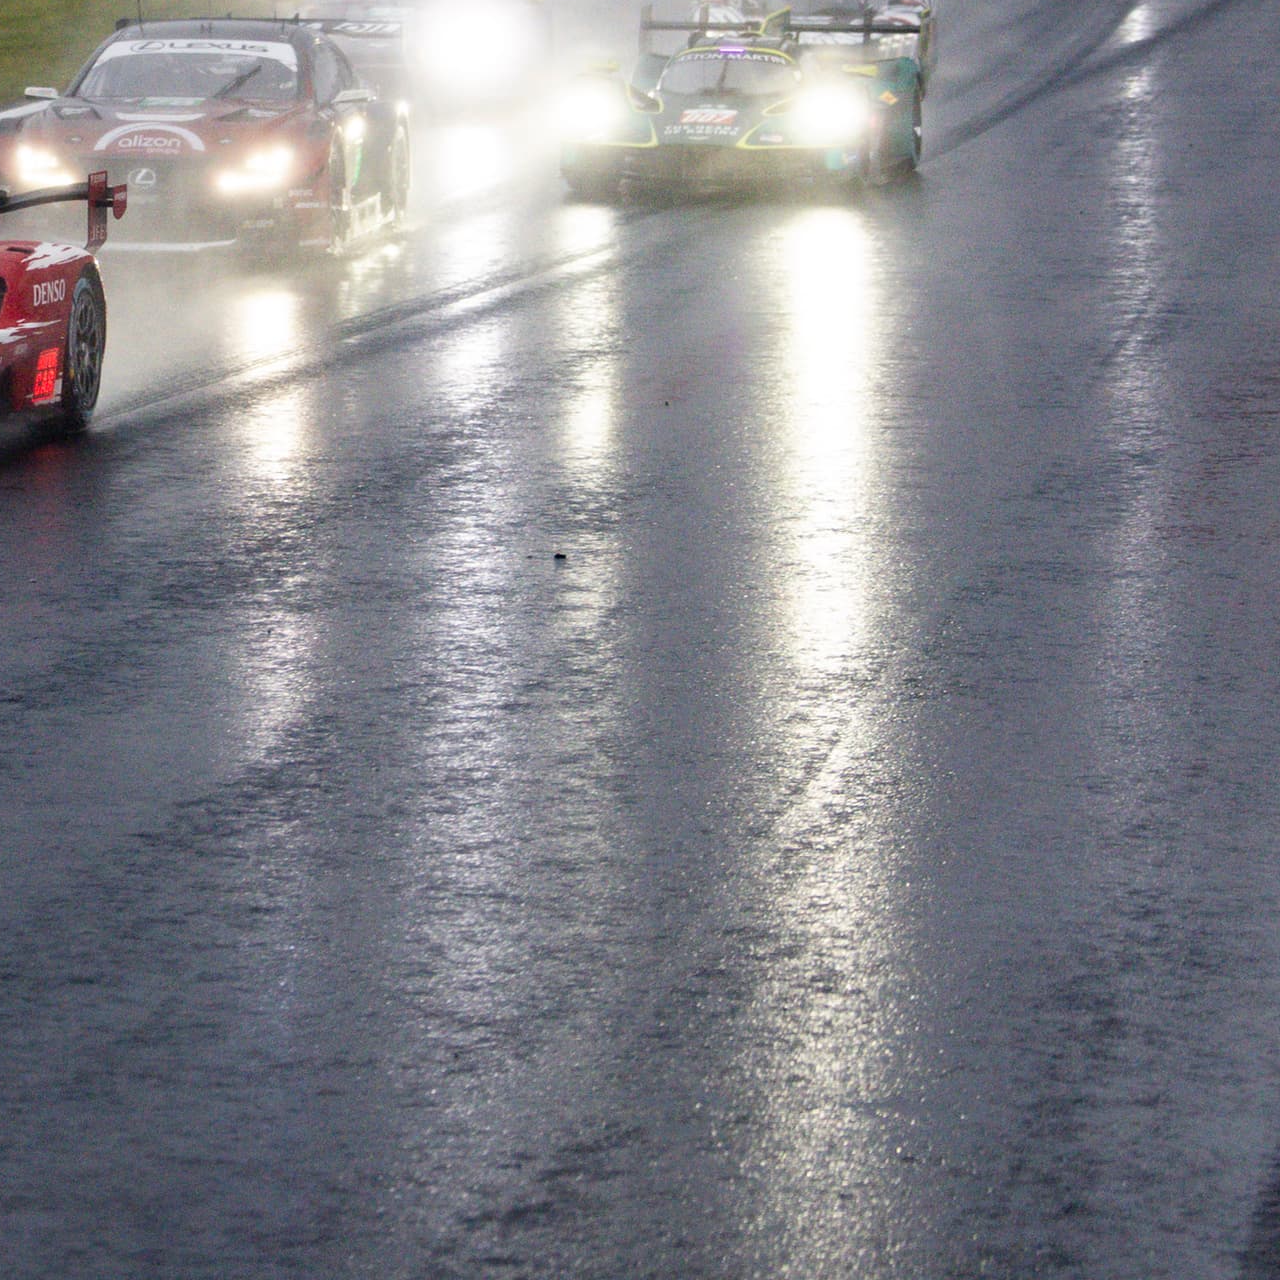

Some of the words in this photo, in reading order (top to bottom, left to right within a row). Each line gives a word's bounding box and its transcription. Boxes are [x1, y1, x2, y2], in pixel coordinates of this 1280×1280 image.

[169, 42, 269, 52] LEXUS
[118, 135, 181, 148] alizon
[33, 279, 66, 307] DENSO
